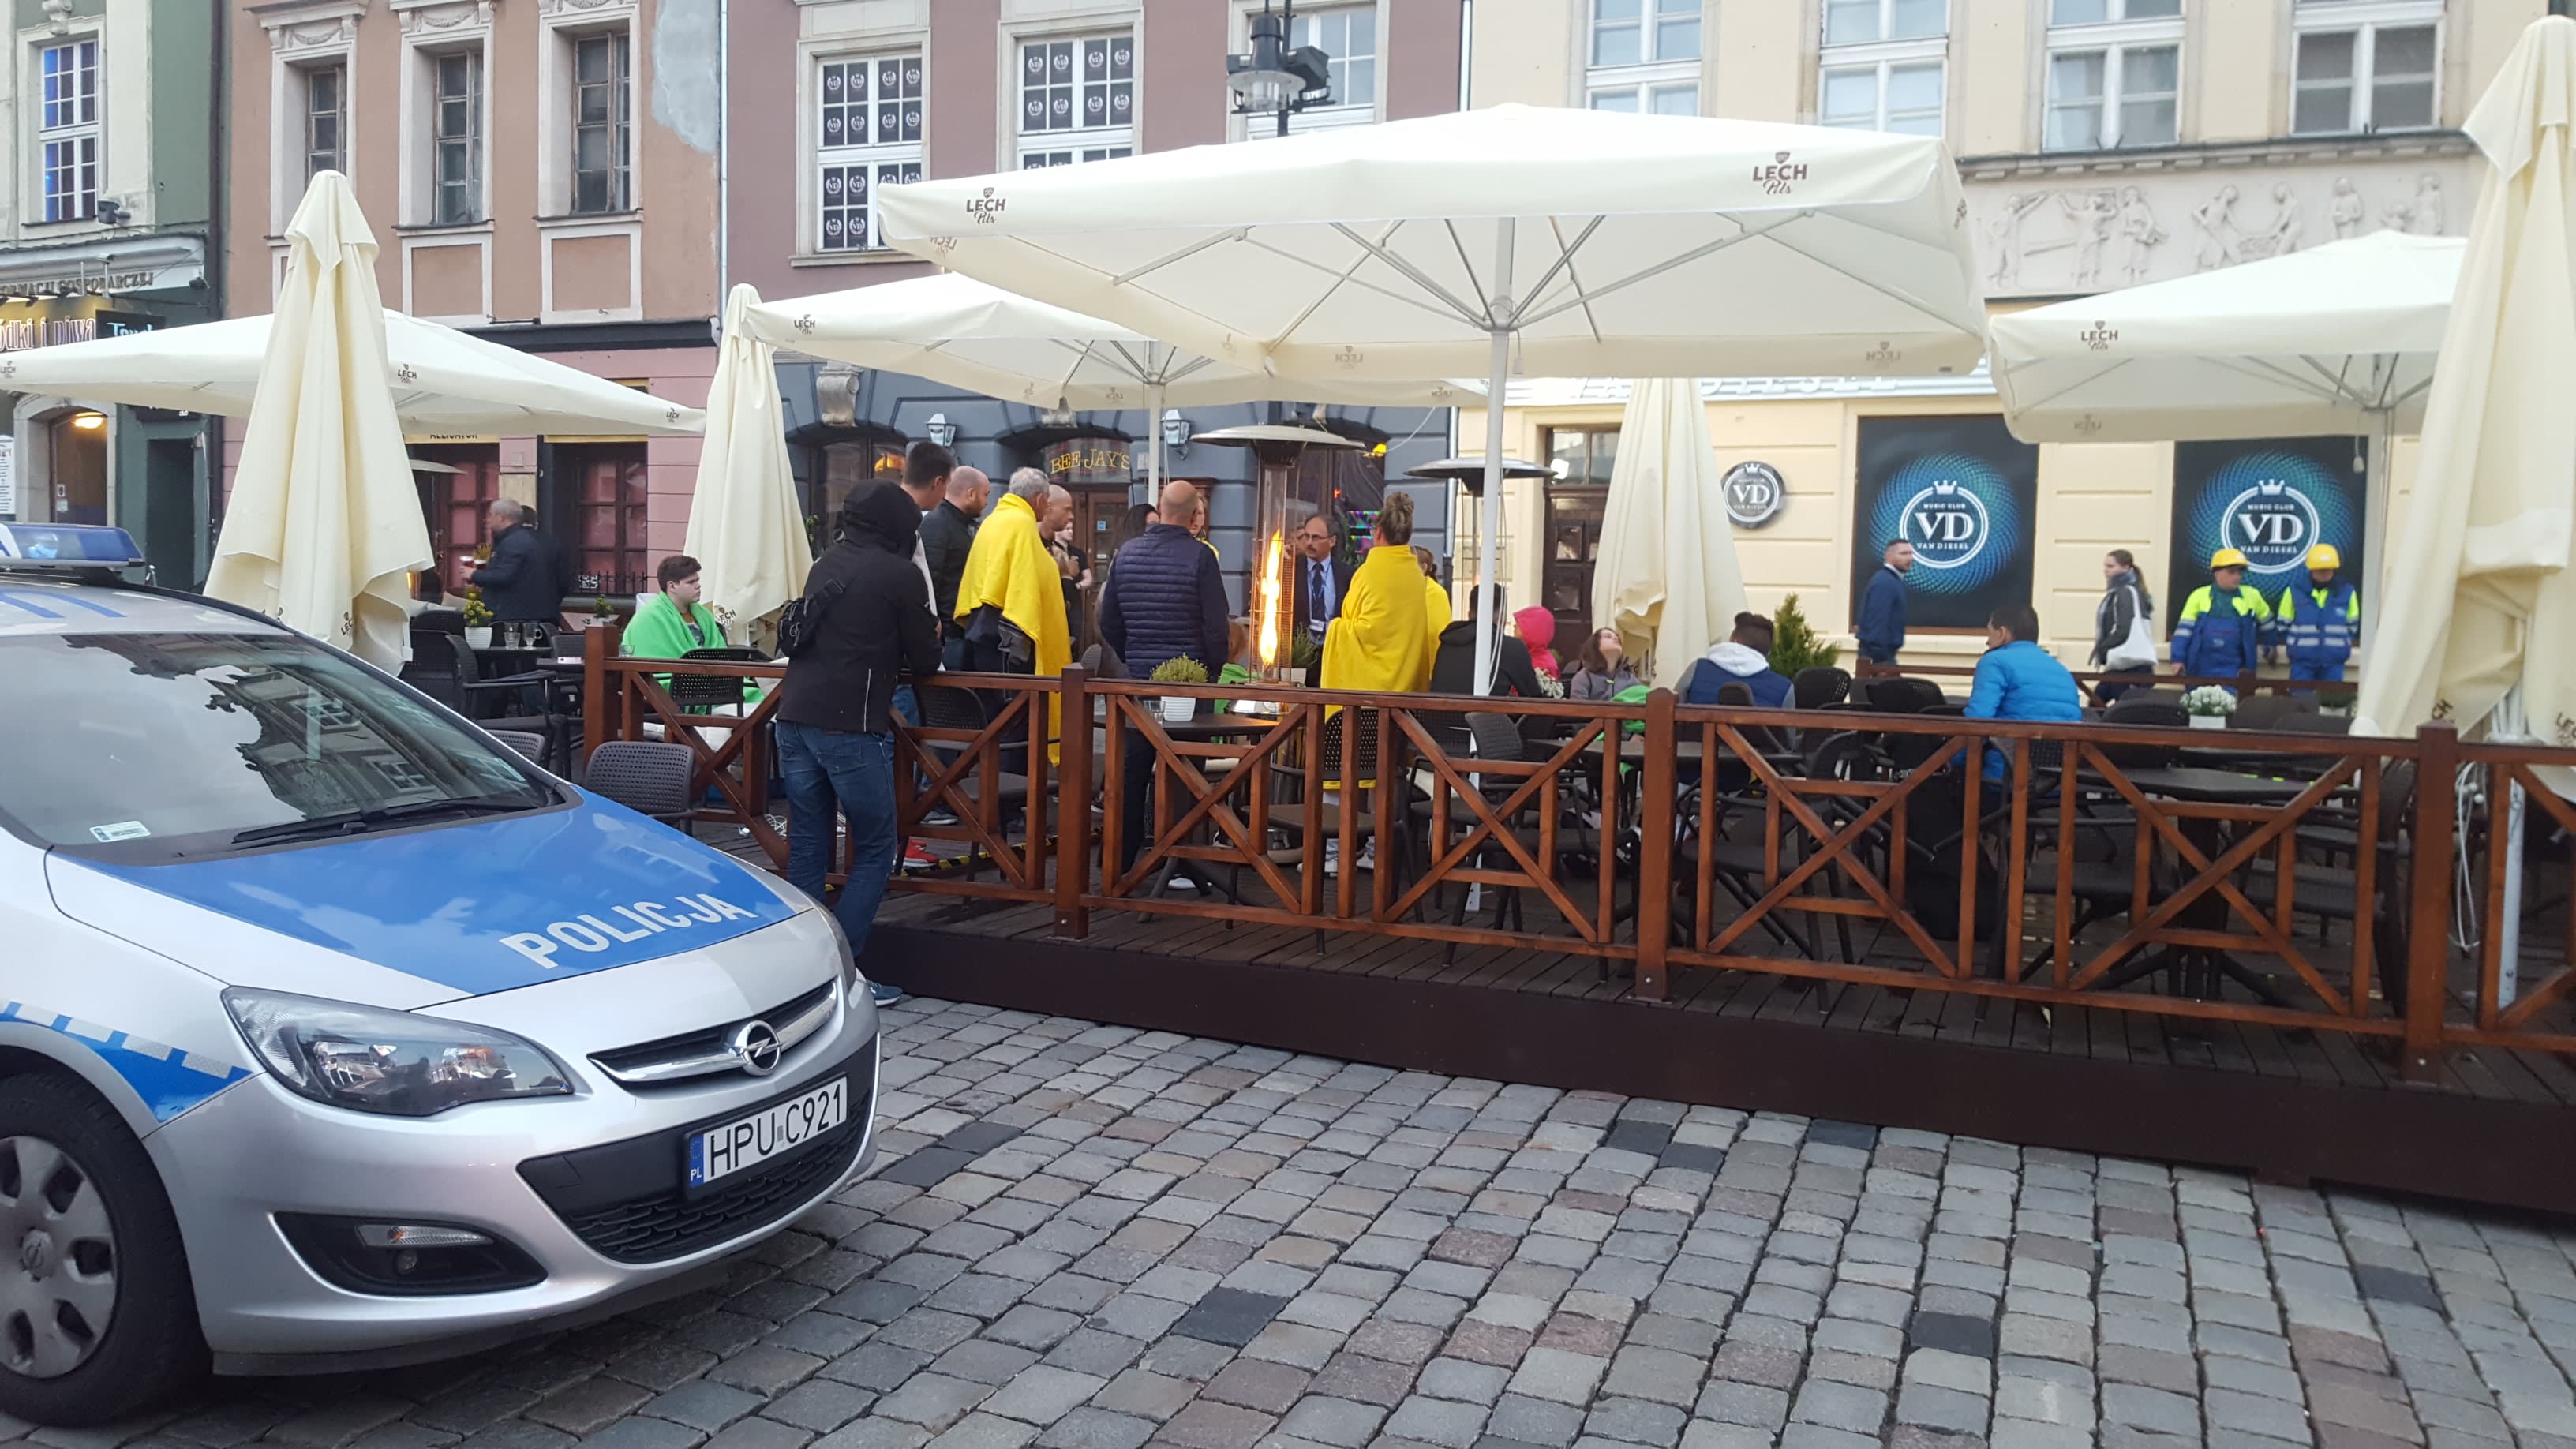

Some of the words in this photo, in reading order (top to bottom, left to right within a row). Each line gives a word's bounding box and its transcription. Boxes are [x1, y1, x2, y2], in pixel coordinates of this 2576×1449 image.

[1753, 164, 1807, 182] LECH
[966, 198, 1006, 212] LECH
[794, 320, 815, 328] LECH
[2081, 330, 2119, 341] LECH
[398, 369, 417, 379] LECH
[1050, 451, 1081, 474] BEE
[1084, 448, 1131, 470] JAY'S
[1732, 485, 1771, 504] VD
[1915, 511, 1974, 541] VD
[2237, 514, 2304, 544] VD
[499, 893, 758, 969] POLICJA
[710, 1112, 776, 1177] HPU
[786, 1084, 841, 1144] C921
[691, 1168, 702, 1181] PL
